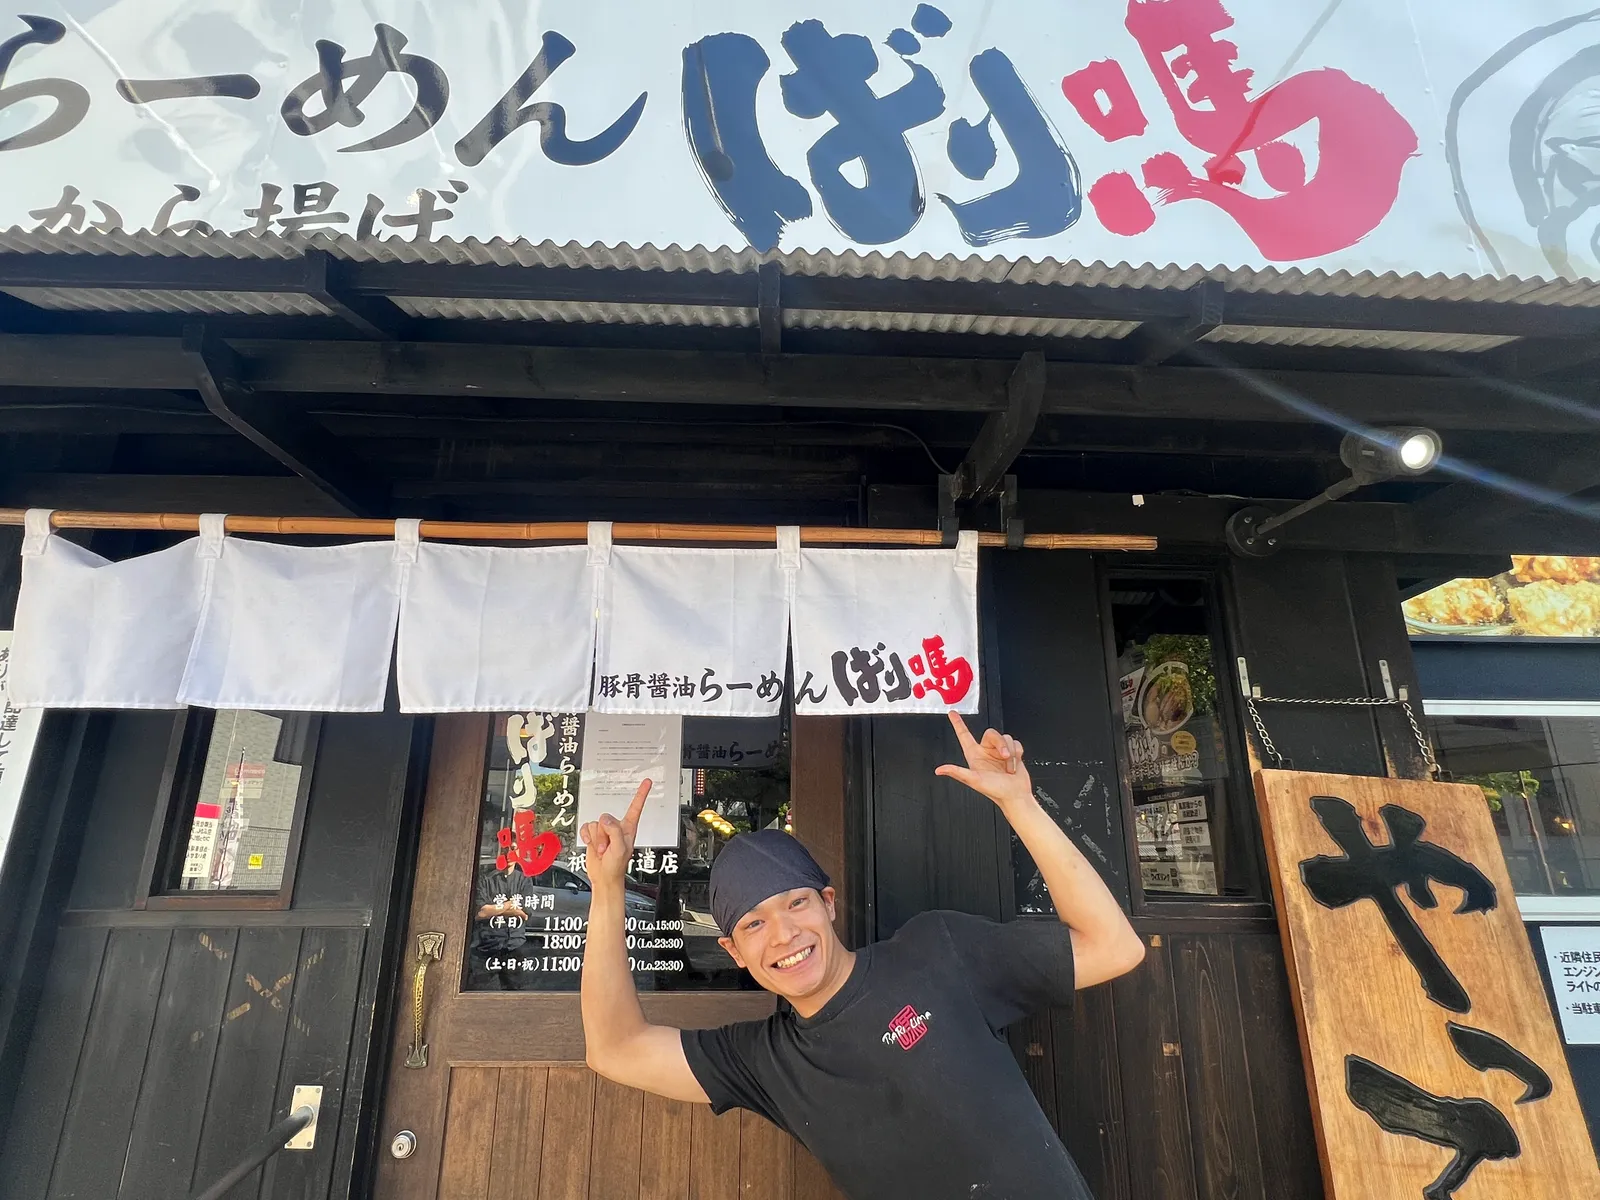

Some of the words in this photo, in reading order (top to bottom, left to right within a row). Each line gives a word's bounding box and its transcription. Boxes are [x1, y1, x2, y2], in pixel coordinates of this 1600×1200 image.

[0, 14, 648, 167] らーめん
[551, 712, 580, 827] 醤油らーめん
[493, 893, 555, 911] 営業時間
